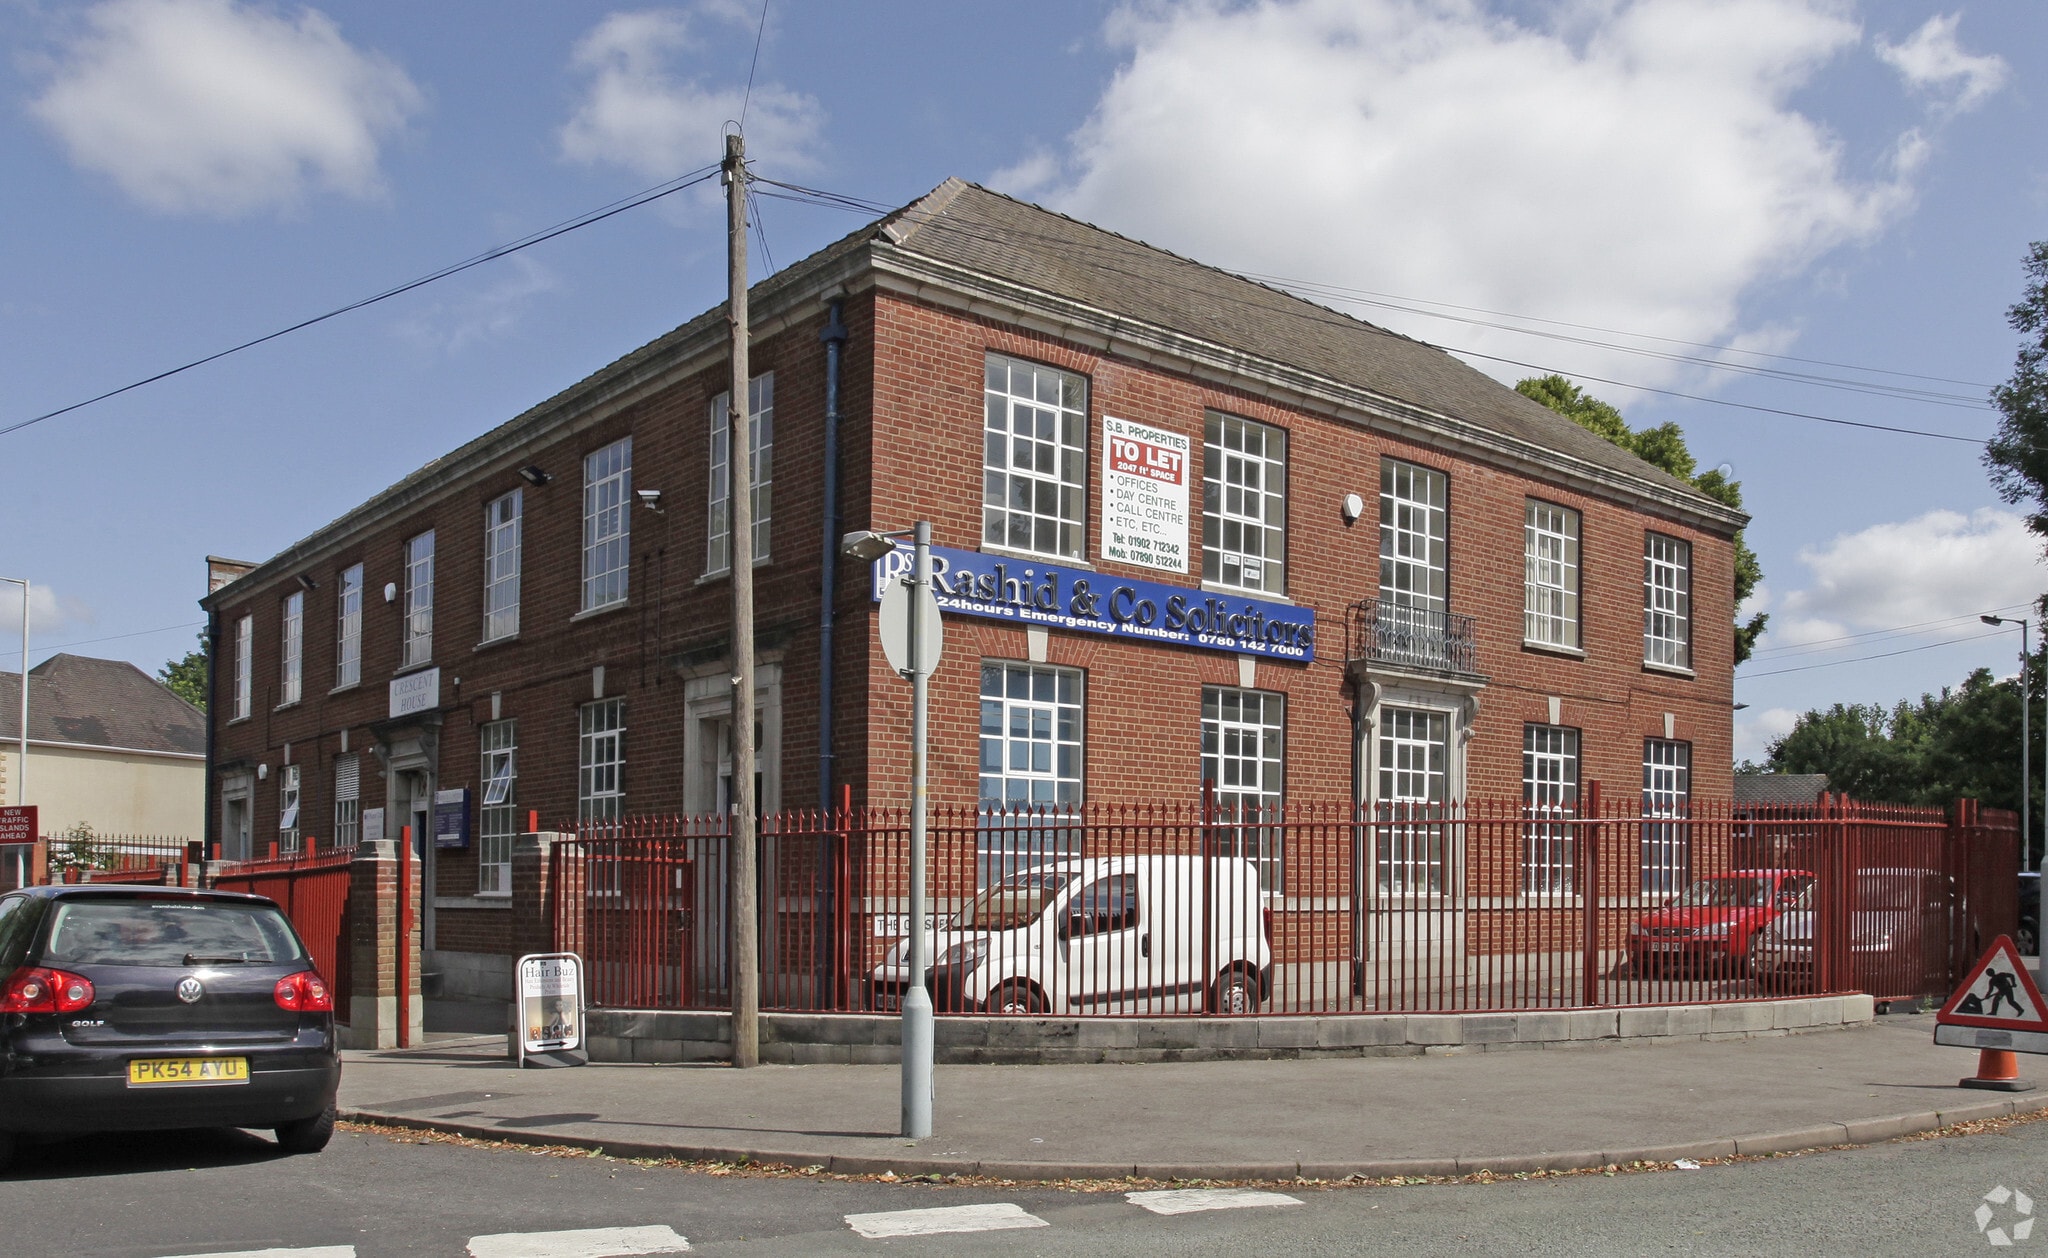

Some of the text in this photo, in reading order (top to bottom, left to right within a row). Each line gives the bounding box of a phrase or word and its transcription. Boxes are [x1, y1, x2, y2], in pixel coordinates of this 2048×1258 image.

[1106, 420, 1187, 450] S.B. PROPERTIES
[1112, 438, 1181, 471] TO LET
[1117, 461, 1137, 472] 2047
[1150, 468, 1175, 482] SPACE
[1117, 475, 1158, 494] OFFICES
[1117, 488, 1176, 511] DAY CENTRE
[1116, 516, 1138, 532] ETC,
[1117, 502, 1183, 525] CALL CENTRE
[1128, 535, 1150, 549] 01902
[1153, 540, 1179, 555] 712342
[1109, 546, 1182, 569] Mob: 07890 512244
[929, 555, 1313, 648] Rashid & Co Solicitors
[937, 596, 1304, 657] 24hours Emergency Number: 0780 142 7000
[394, 673, 434, 697] CRESCENT
[400, 693, 426, 712] HOUSE
[4, 808, 22, 816] NEW
[525, 965, 575, 978] Hair Buz
[138, 1060, 237, 1079] PK54 AYU
